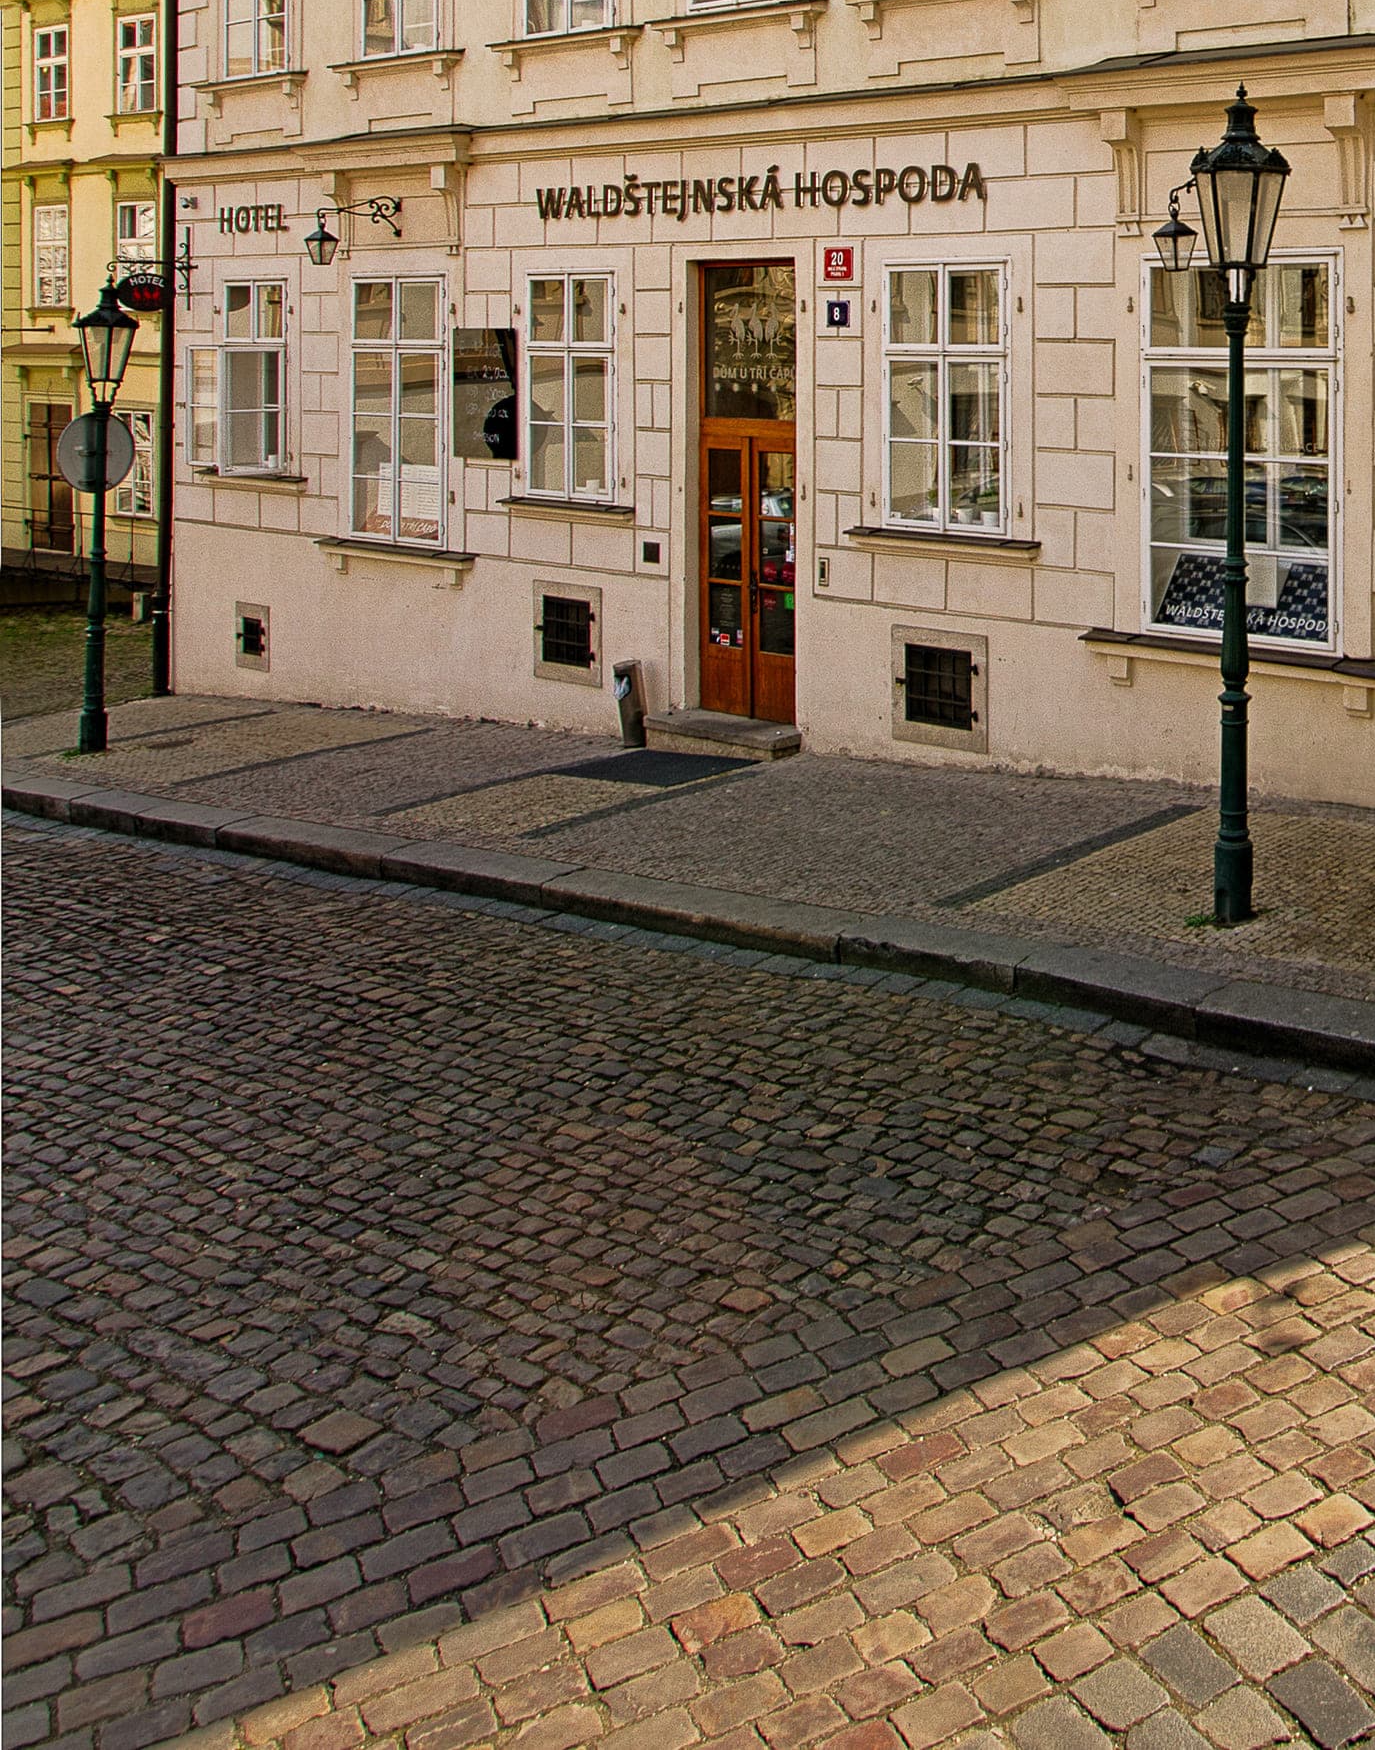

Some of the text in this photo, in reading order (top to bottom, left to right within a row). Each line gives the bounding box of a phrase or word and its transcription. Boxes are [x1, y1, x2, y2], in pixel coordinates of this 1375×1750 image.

[536, 162, 987, 222] WALDŠTEJNSKÁ HOSPODA
[219, 203, 290, 234] HOTEL
[831, 251, 843, 265] 20
[128, 275, 165, 288] HOTEL
[833, 307, 840, 321] 8
[740, 368, 748, 379] U
[750, 365, 767, 380] TŘÍ
[1165, 604, 1265, 626] WALDŠTEKÁ
